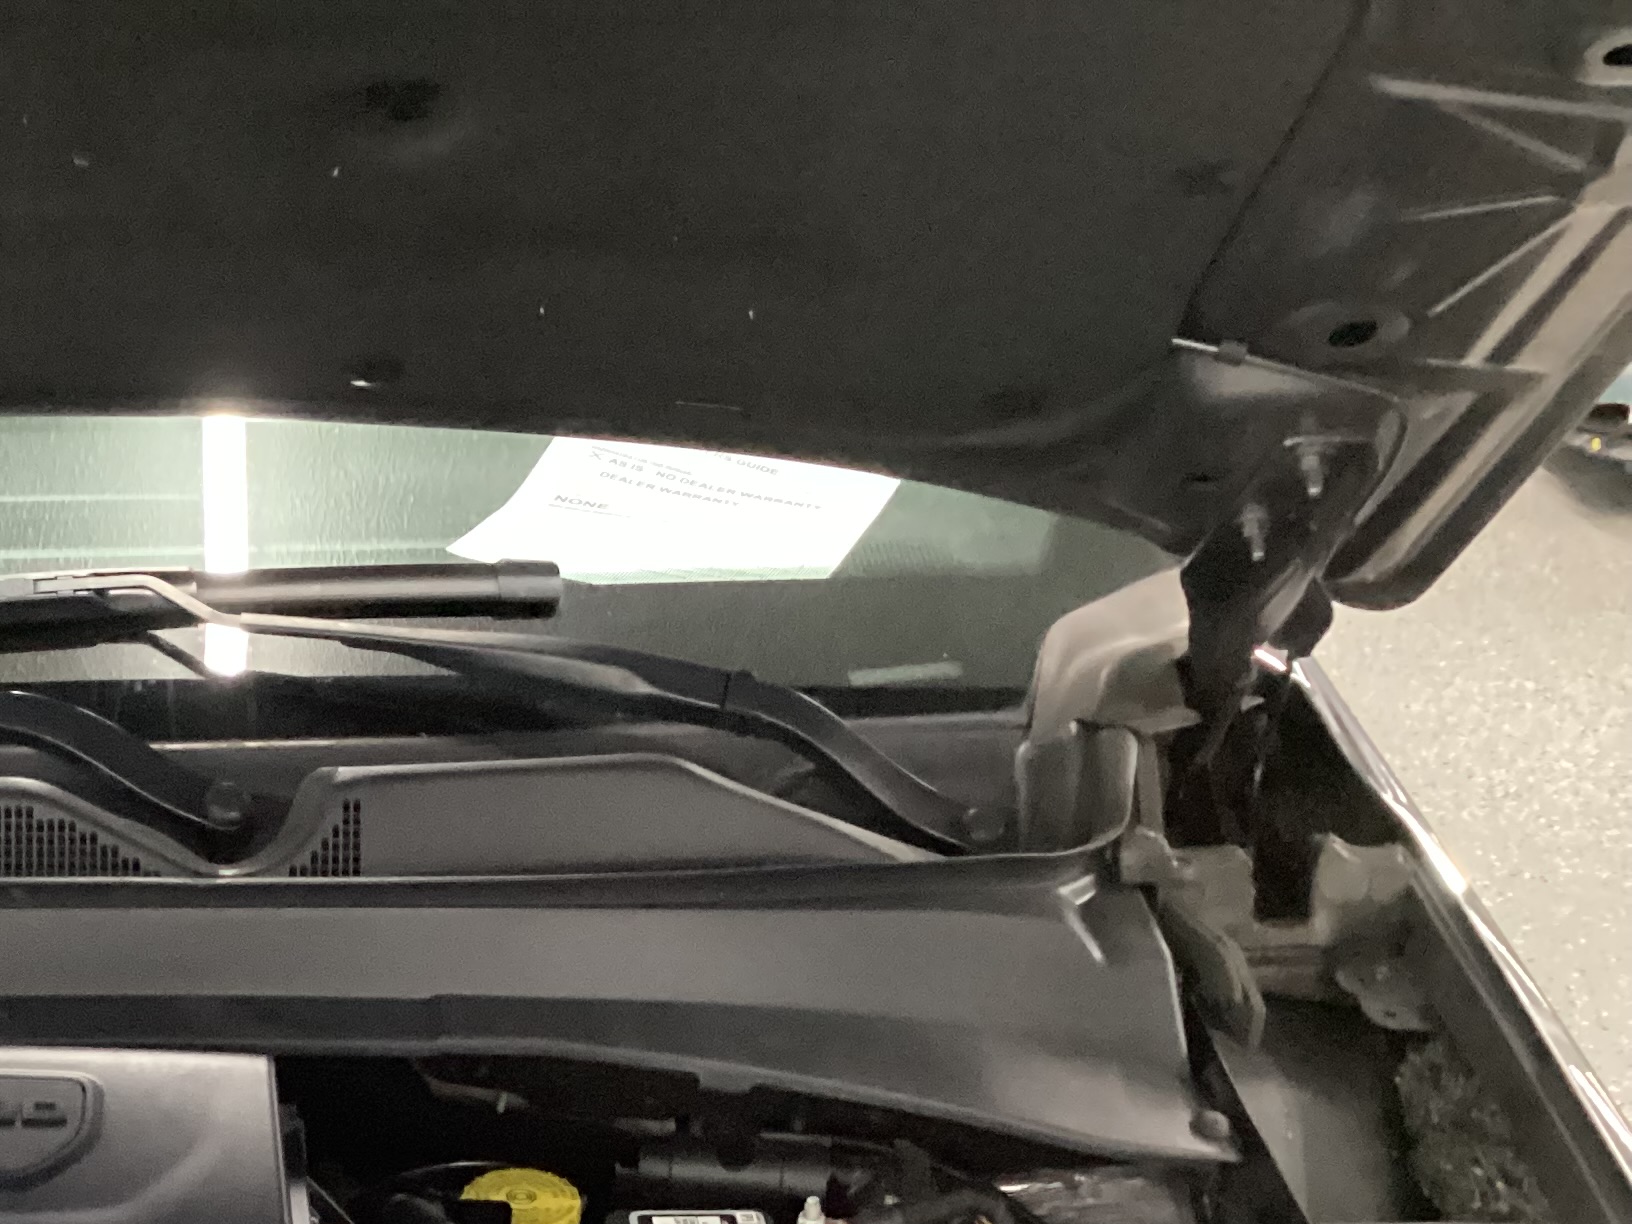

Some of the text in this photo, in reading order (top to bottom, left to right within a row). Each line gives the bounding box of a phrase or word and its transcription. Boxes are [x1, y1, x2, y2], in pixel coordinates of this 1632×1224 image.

[736, 459, 779, 476] GUIDE
[599, 470, 740, 506] DEALER WARRANTY
[608, 457, 627, 468] AS
[656, 470, 675, 481] NO
[680, 477, 736, 495] DEALER
[740, 490, 822, 510] WARRANTY
[554, 494, 609, 510] NONE
